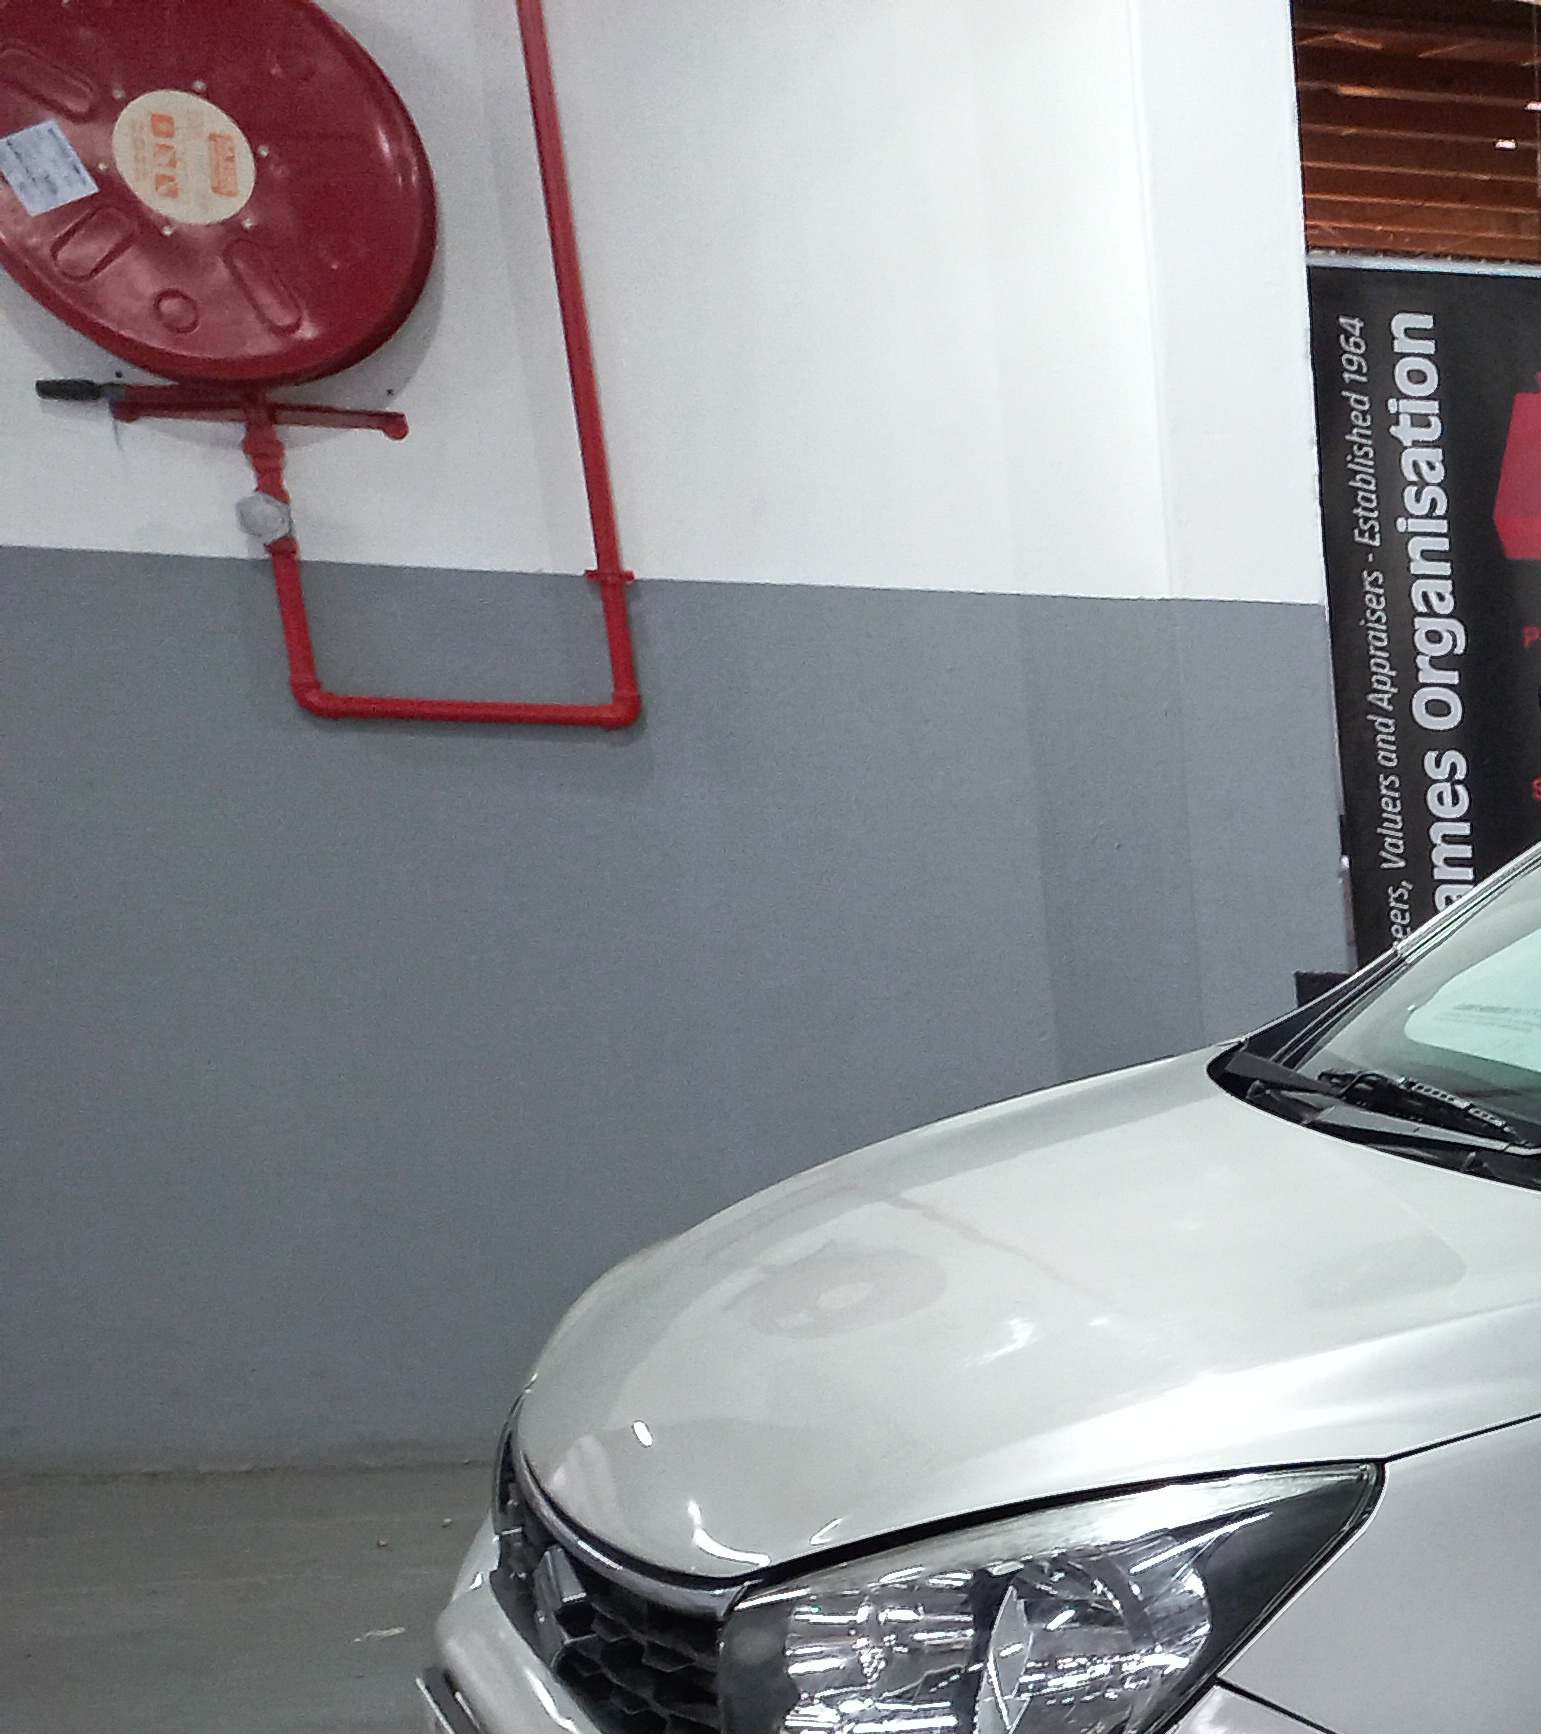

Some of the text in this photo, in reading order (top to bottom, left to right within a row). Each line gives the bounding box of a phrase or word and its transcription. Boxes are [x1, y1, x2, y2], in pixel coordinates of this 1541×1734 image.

[1338, 316, 1368, 383] 1964
[1341, 390, 1381, 547] Established
[1387, 313, 1466, 731] Organisation
[1359, 569, 1399, 712] Appraisers
[1366, 714, 1398, 767] and
[1376, 773, 1406, 869] Valuers
